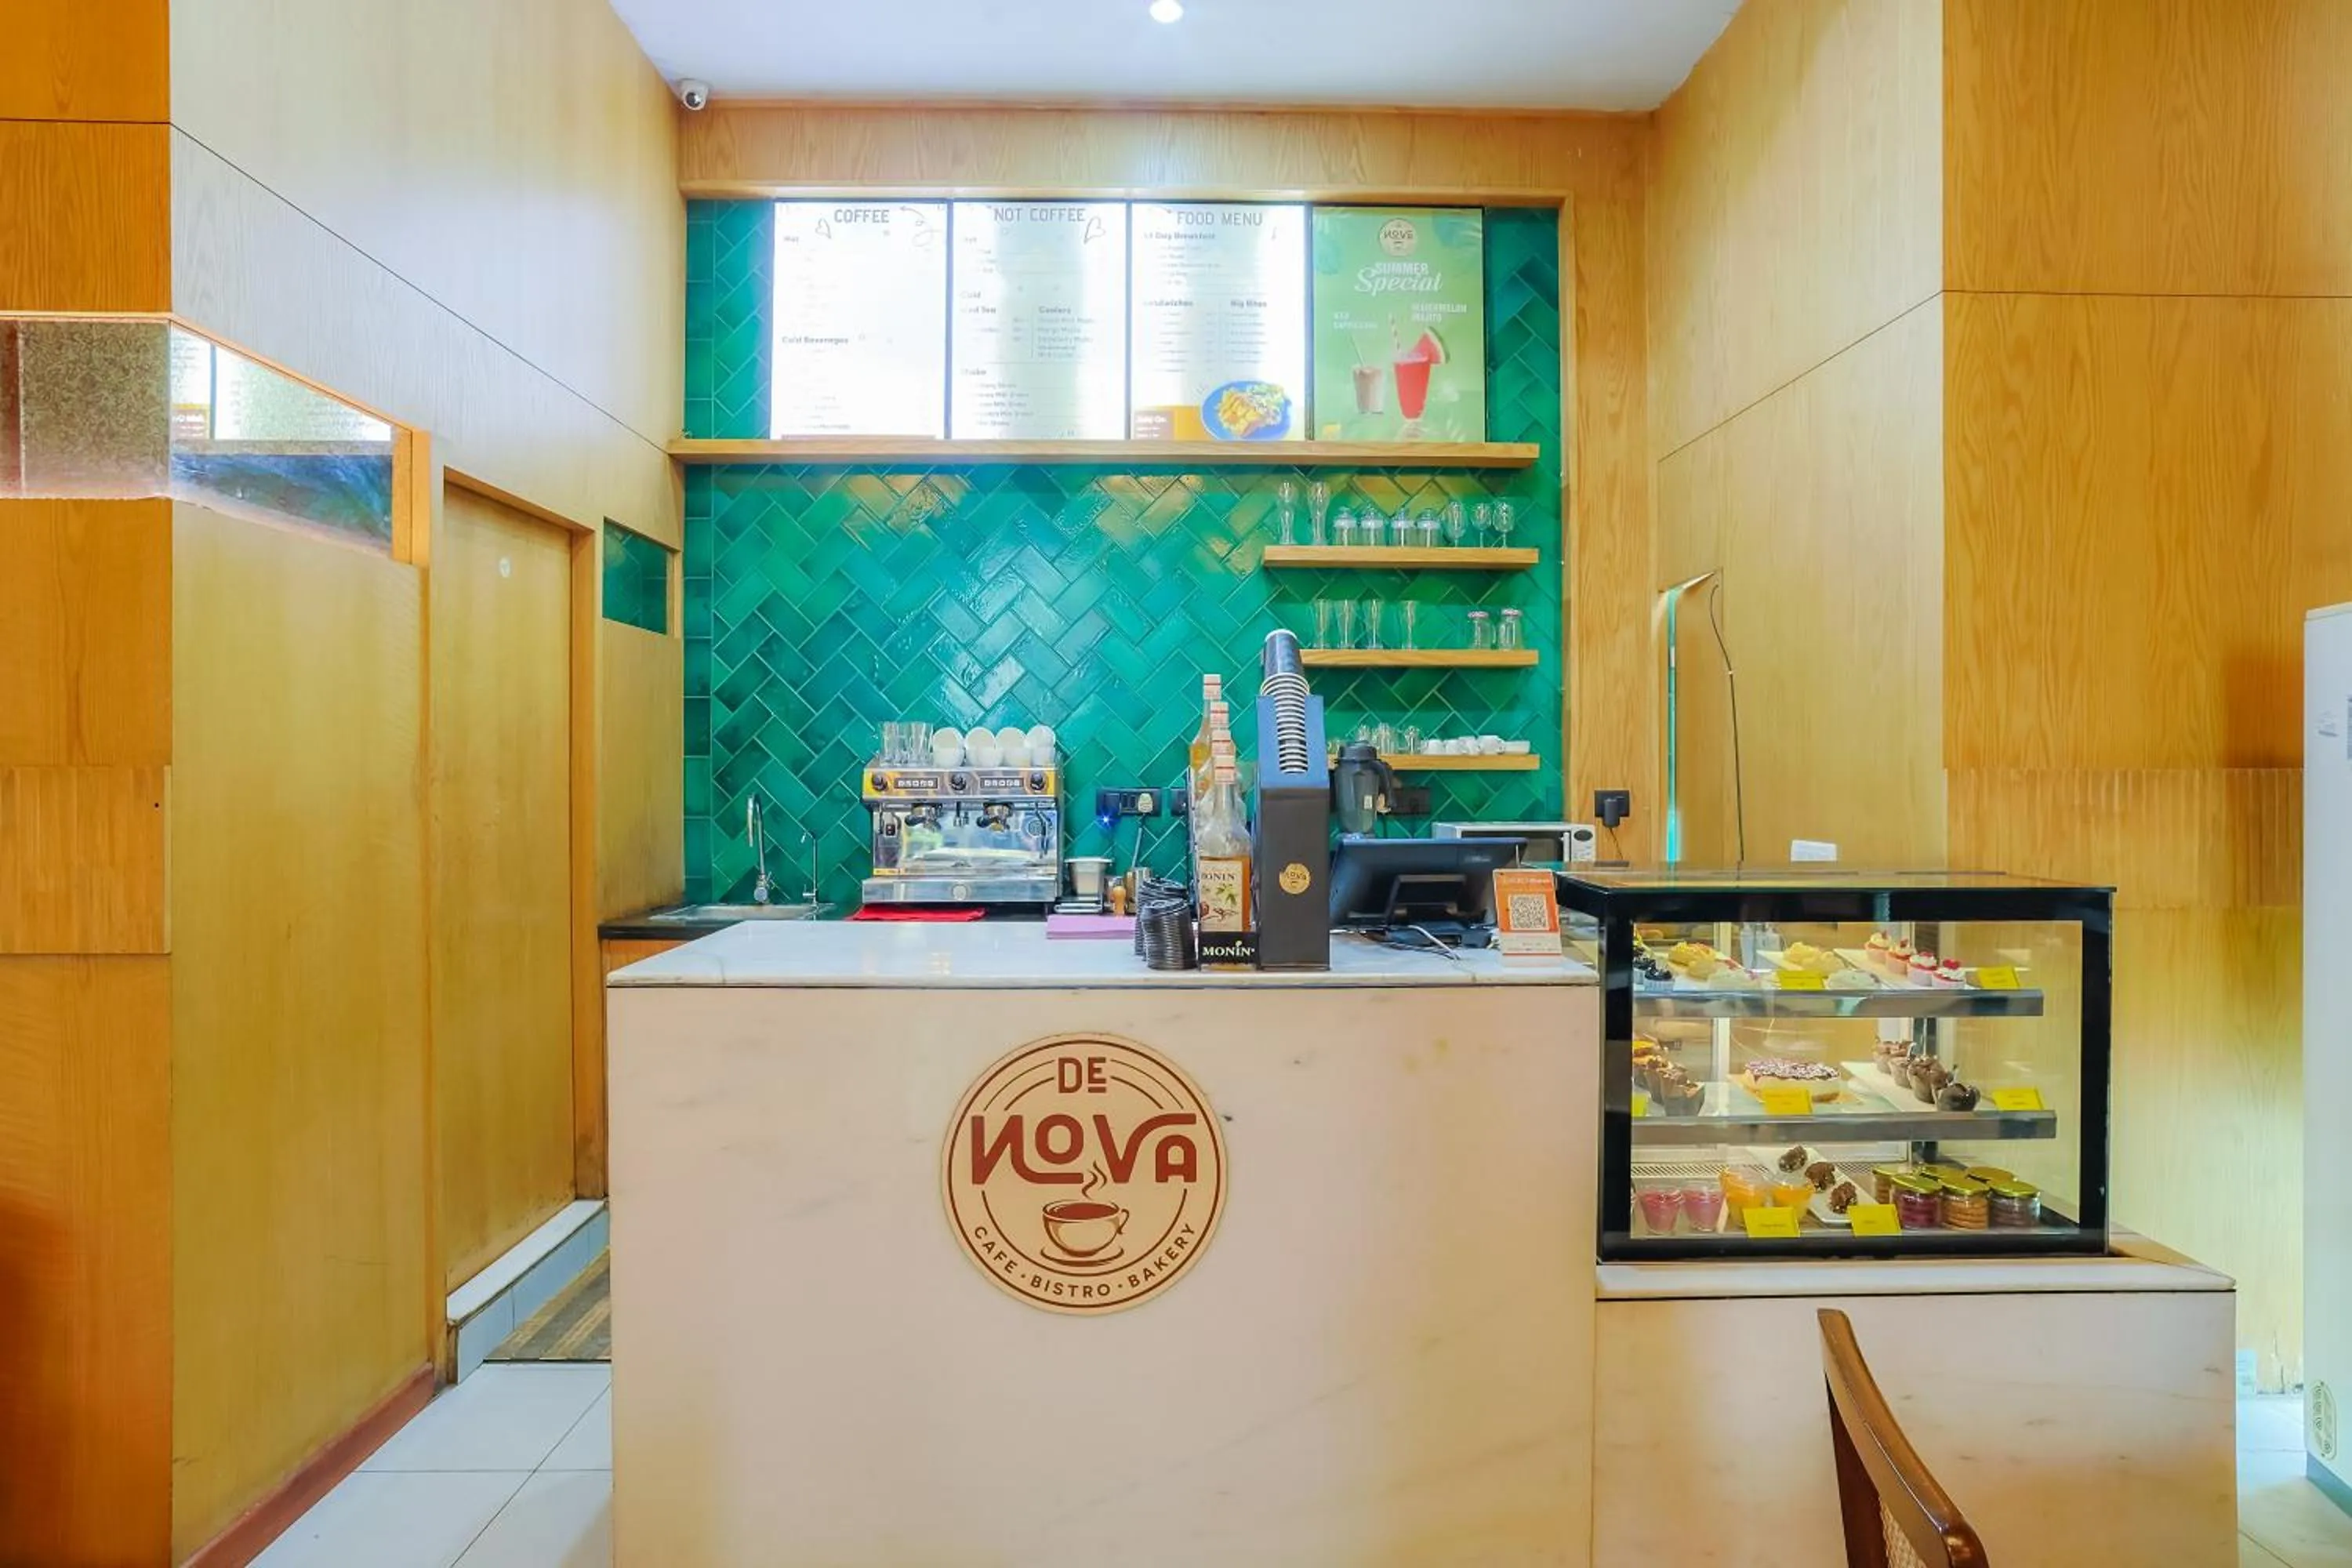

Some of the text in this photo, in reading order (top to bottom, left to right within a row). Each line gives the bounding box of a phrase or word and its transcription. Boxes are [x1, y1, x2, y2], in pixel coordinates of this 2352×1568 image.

[834, 209, 890, 223] COFFEE
[994, 208, 1086, 222] NOT COFFEE
[1177, 211, 1263, 226] FOOD MENU
[1374, 262, 1429, 275] SUMMER
[1354, 267, 1444, 297] Special
[1202, 941, 1251, 956] MONIN
[1058, 1057, 1107, 1094] DE
[971, 1113, 1197, 1185] NOVA
[975, 1223, 1196, 1298] CAFE BISTRO BAKERY
